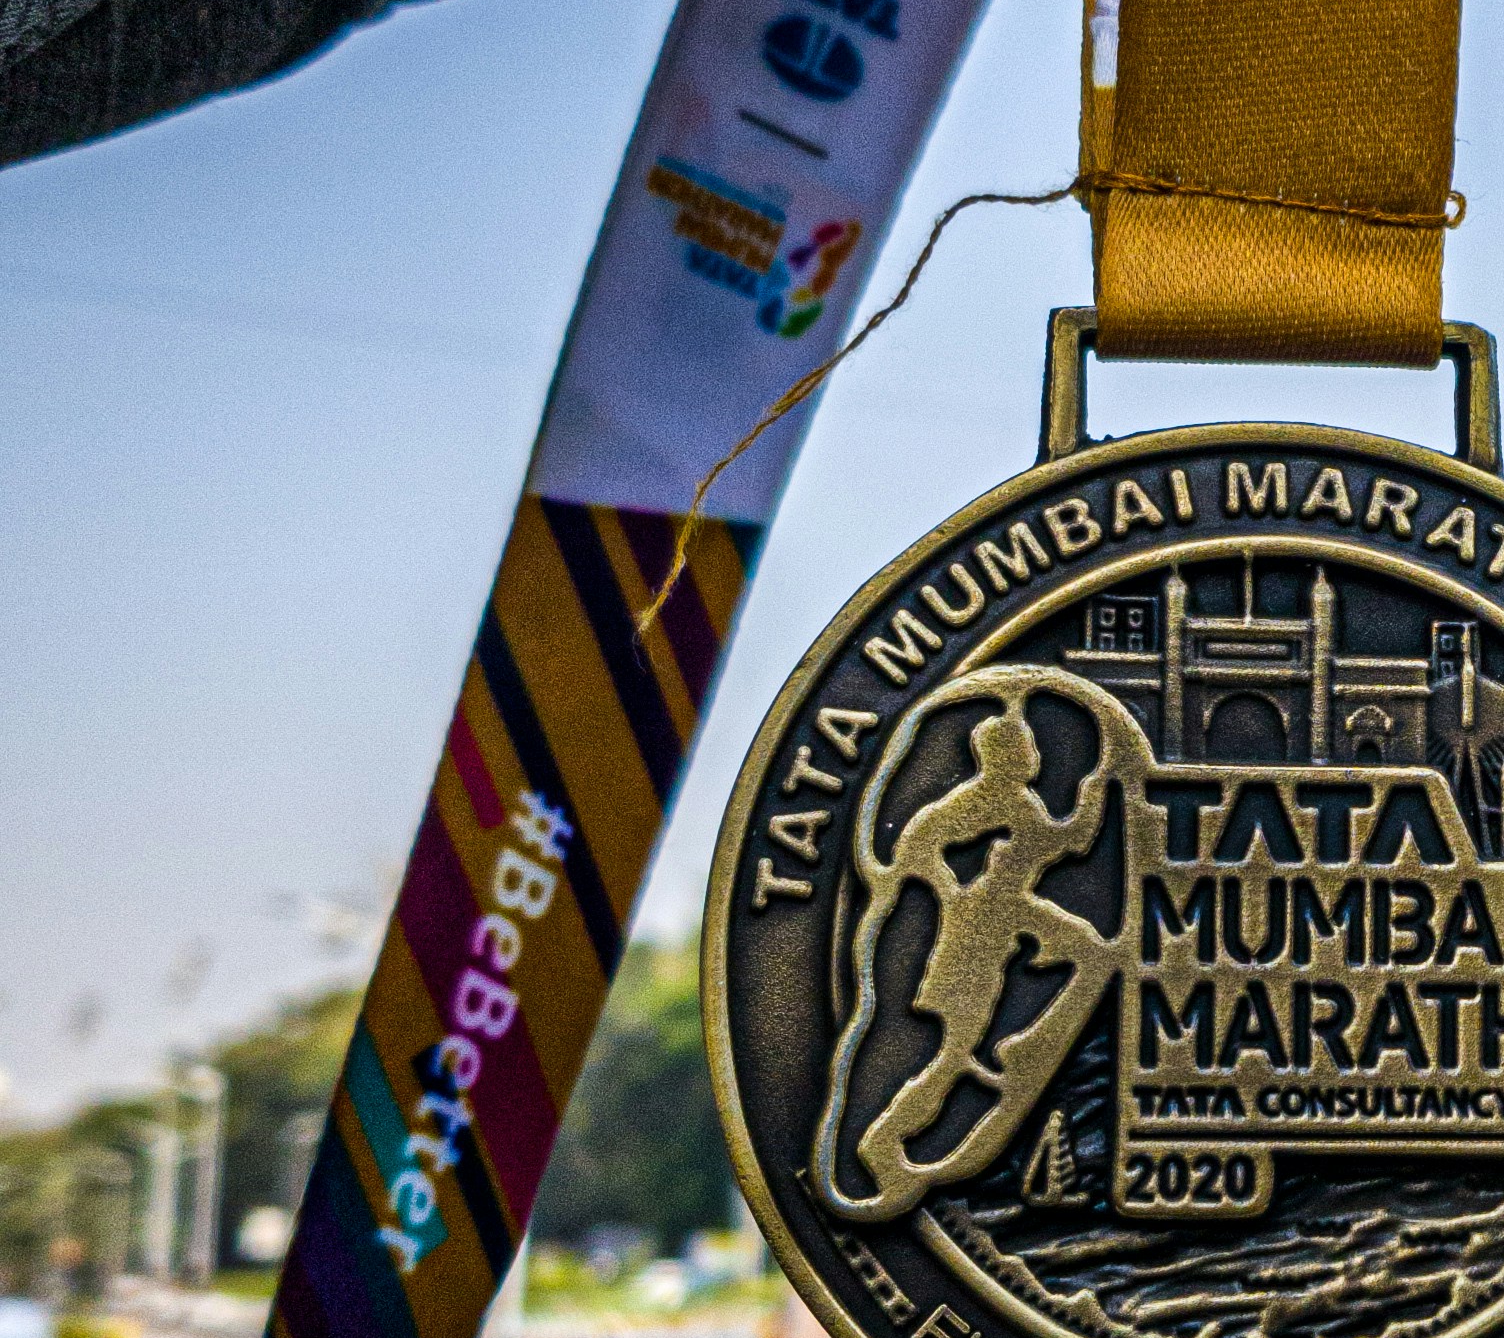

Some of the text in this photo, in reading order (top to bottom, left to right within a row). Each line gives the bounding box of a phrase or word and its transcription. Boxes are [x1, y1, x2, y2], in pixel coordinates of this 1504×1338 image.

[751, 705, 879, 911] TATA
[862, 468, 1194, 687] MUMBAI
[1145, 780, 1456, 864] TATA
[377, 788, 575, 1274] #BeBetter
[1132, 1086, 1246, 1119] TATA
[1124, 1153, 1257, 1205] 2020
